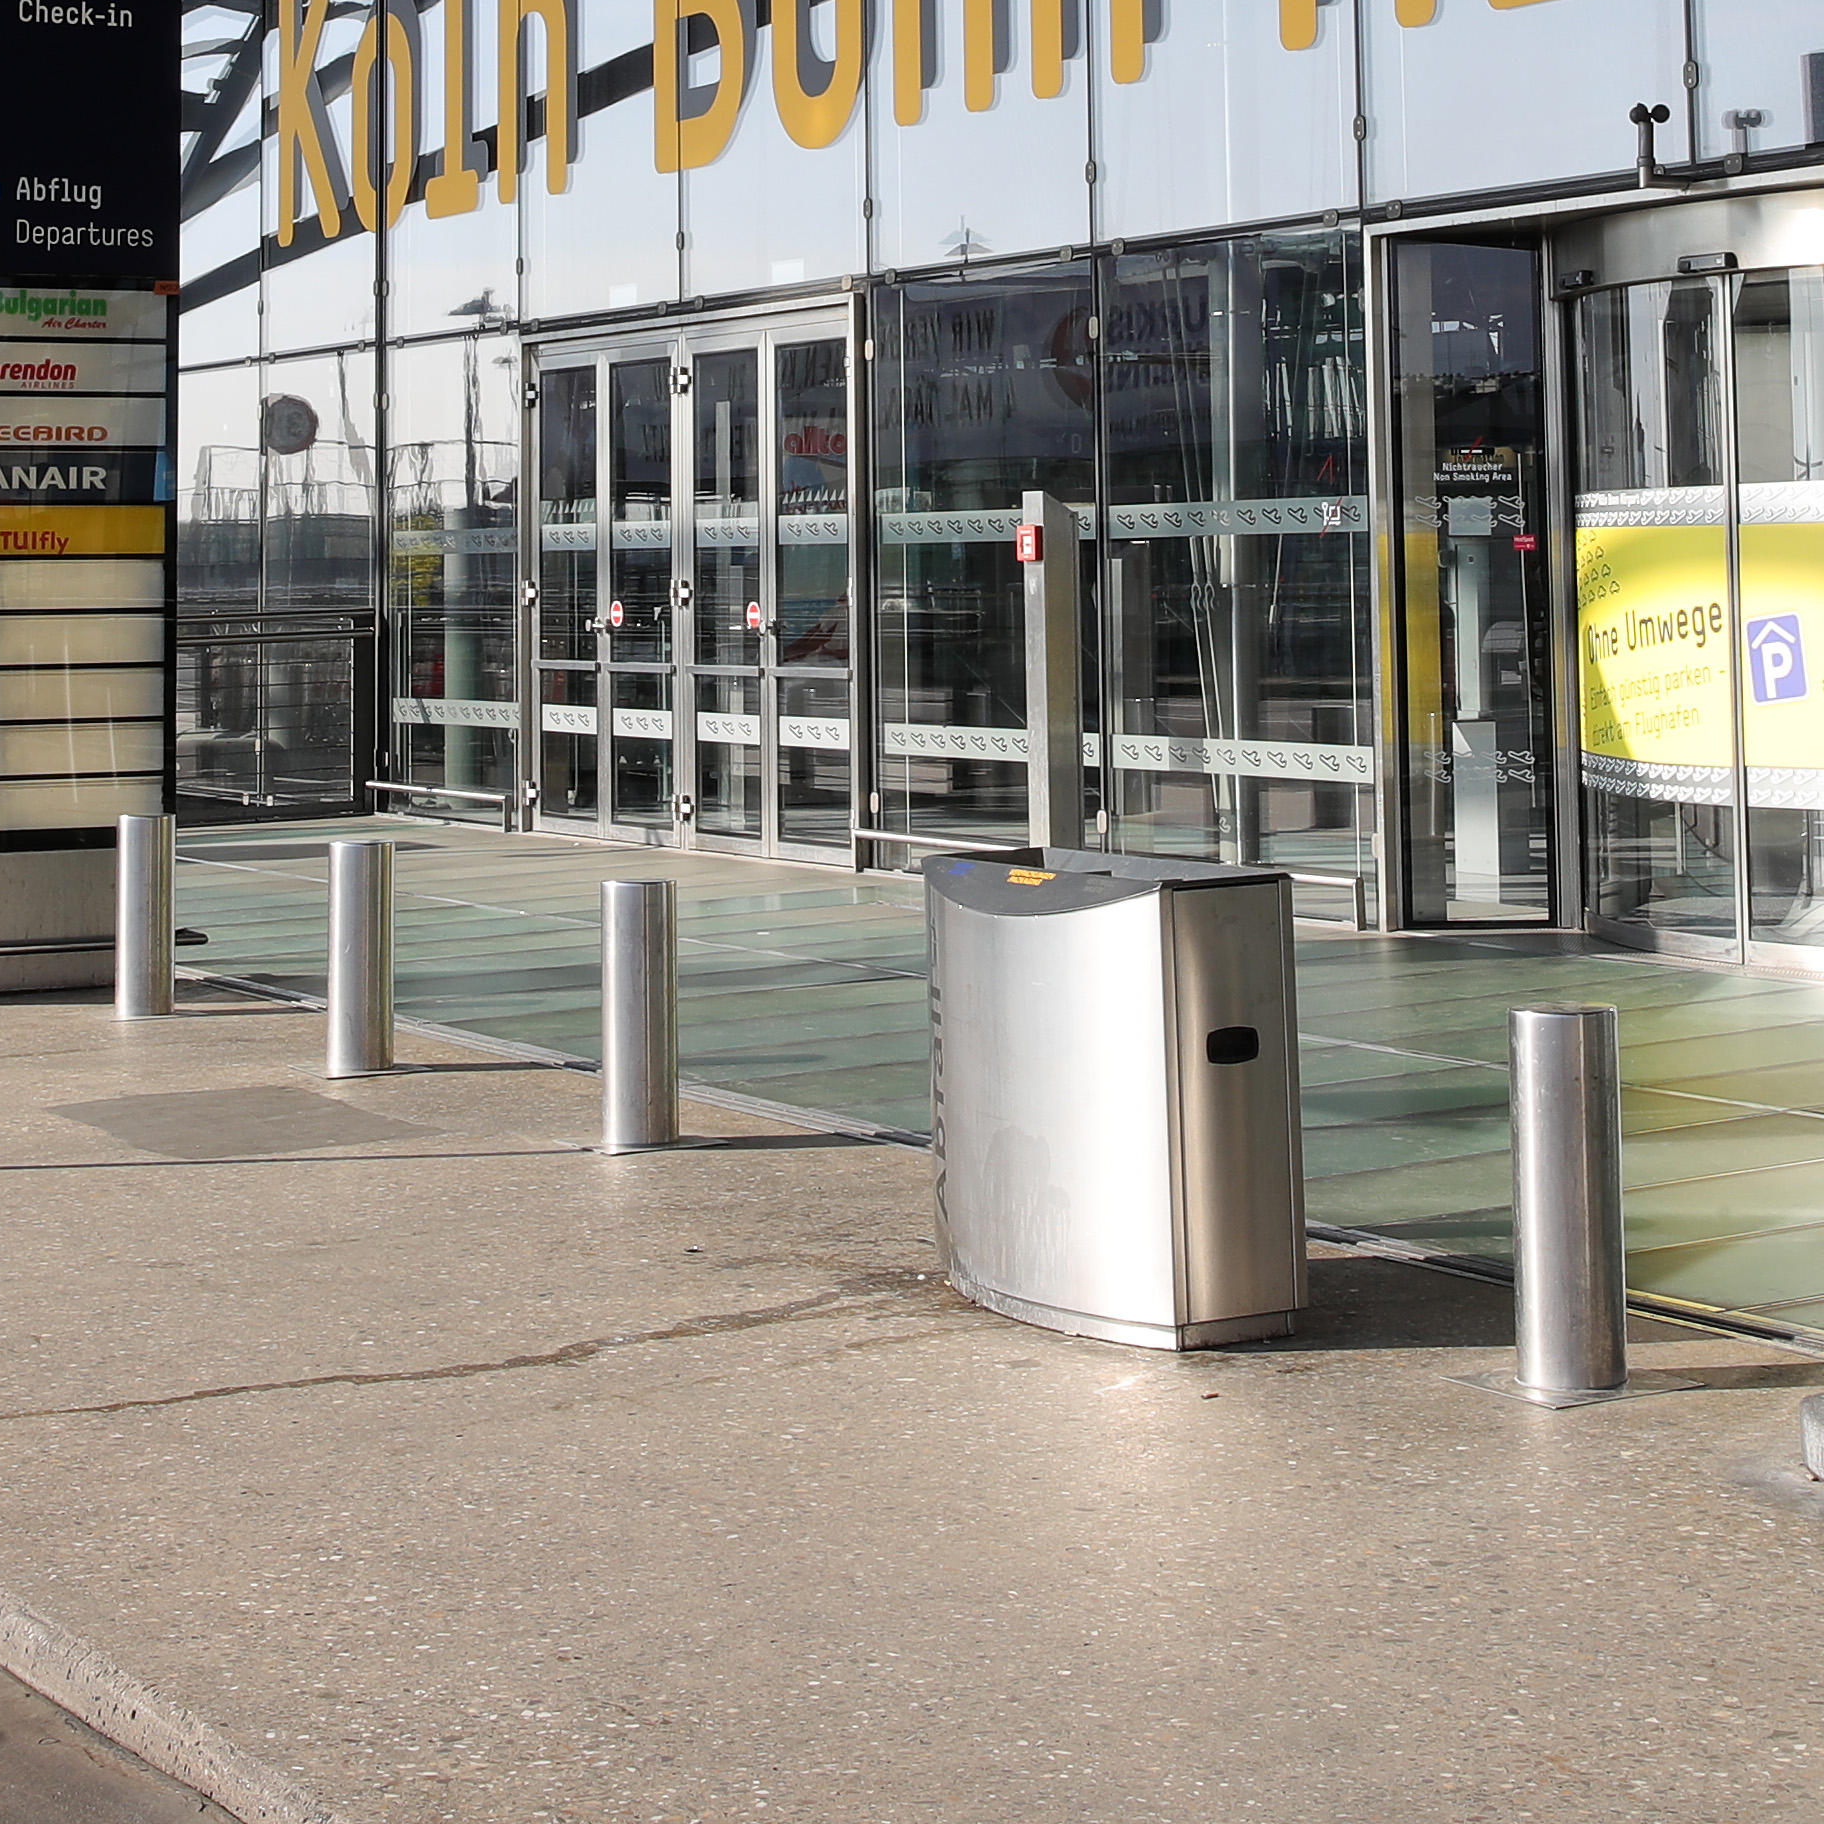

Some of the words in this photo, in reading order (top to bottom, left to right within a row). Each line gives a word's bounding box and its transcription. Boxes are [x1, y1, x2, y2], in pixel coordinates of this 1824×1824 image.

[16, 177, 103, 210] Abflug
[16, 220, 154, 251] Departures
[41, 317, 61, 329] Air
[64, 317, 107, 330] Charter
[20, 380, 75, 389] AIRLINES
[1433, 472, 1450, 481] Non
[1453, 472, 1490, 483] Smoking
[1492, 472, 1512, 481] Area
[1442, 463, 1503, 472] Nichtraucher
[0, 530, 69, 555] TUIfly
[1587, 622, 1619, 666] Ohne
[1625, 602, 1722, 651] Umwege
[1590, 679, 1616, 711] Einfach
[1619, 671, 1661, 708] günstig
[1664, 664, 1712, 698] parken
[1635, 704, 1700, 739] Flughafen
